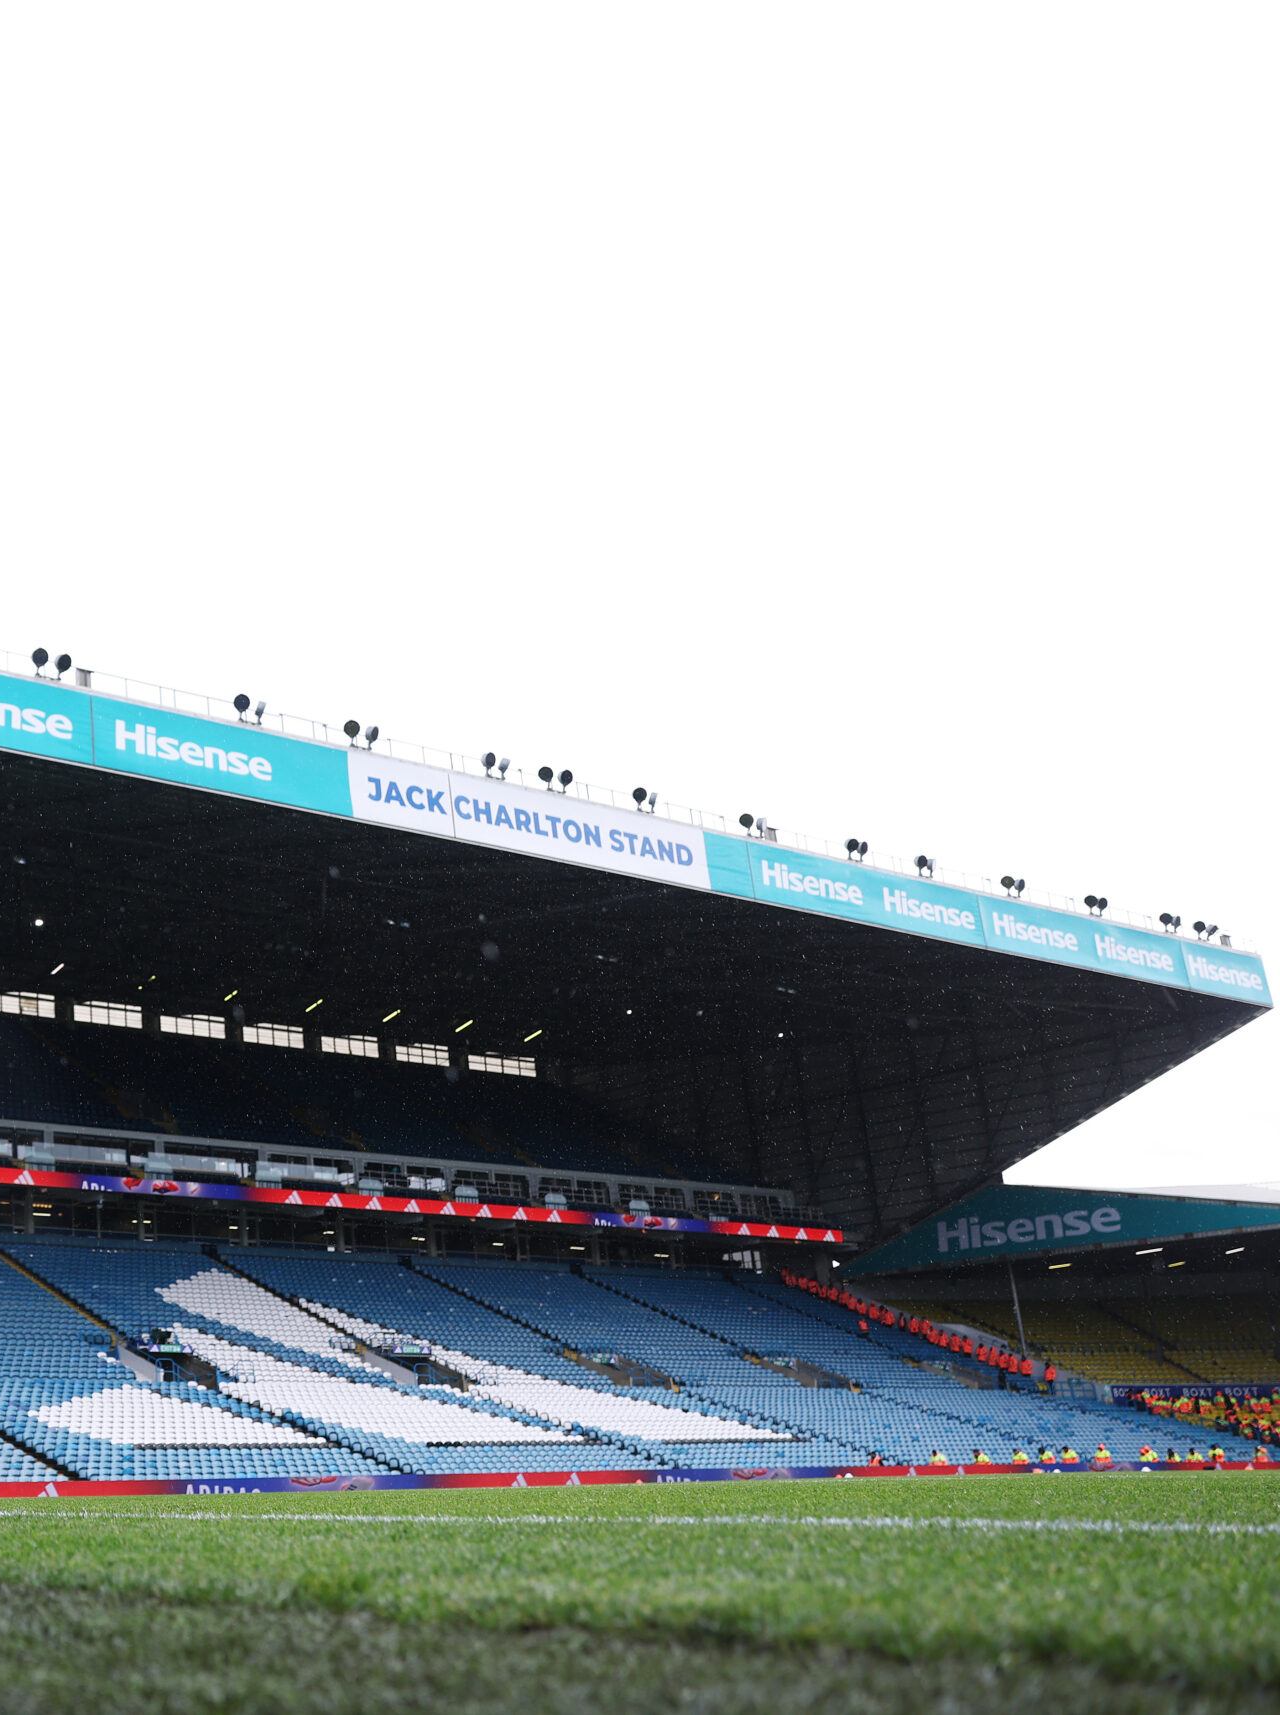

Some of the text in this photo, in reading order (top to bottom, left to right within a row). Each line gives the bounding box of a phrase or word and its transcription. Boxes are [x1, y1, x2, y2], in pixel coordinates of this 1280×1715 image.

[114, 718, 273, 782] Hisense
[366, 775, 694, 868] JACK CHARLTON STAND
[761, 860, 864, 906] Hisense
[882, 886, 976, 930] Hisense
[992, 911, 1079, 951] Hisense
[1093, 933, 1174, 972] Hisense
[1187, 956, 1263, 990] Hisense
[936, 1206, 1122, 1254] Hisense
[1182, 1387, 1213, 1398] BOXT
[1225, 1386, 1258, 1398] BOXT
